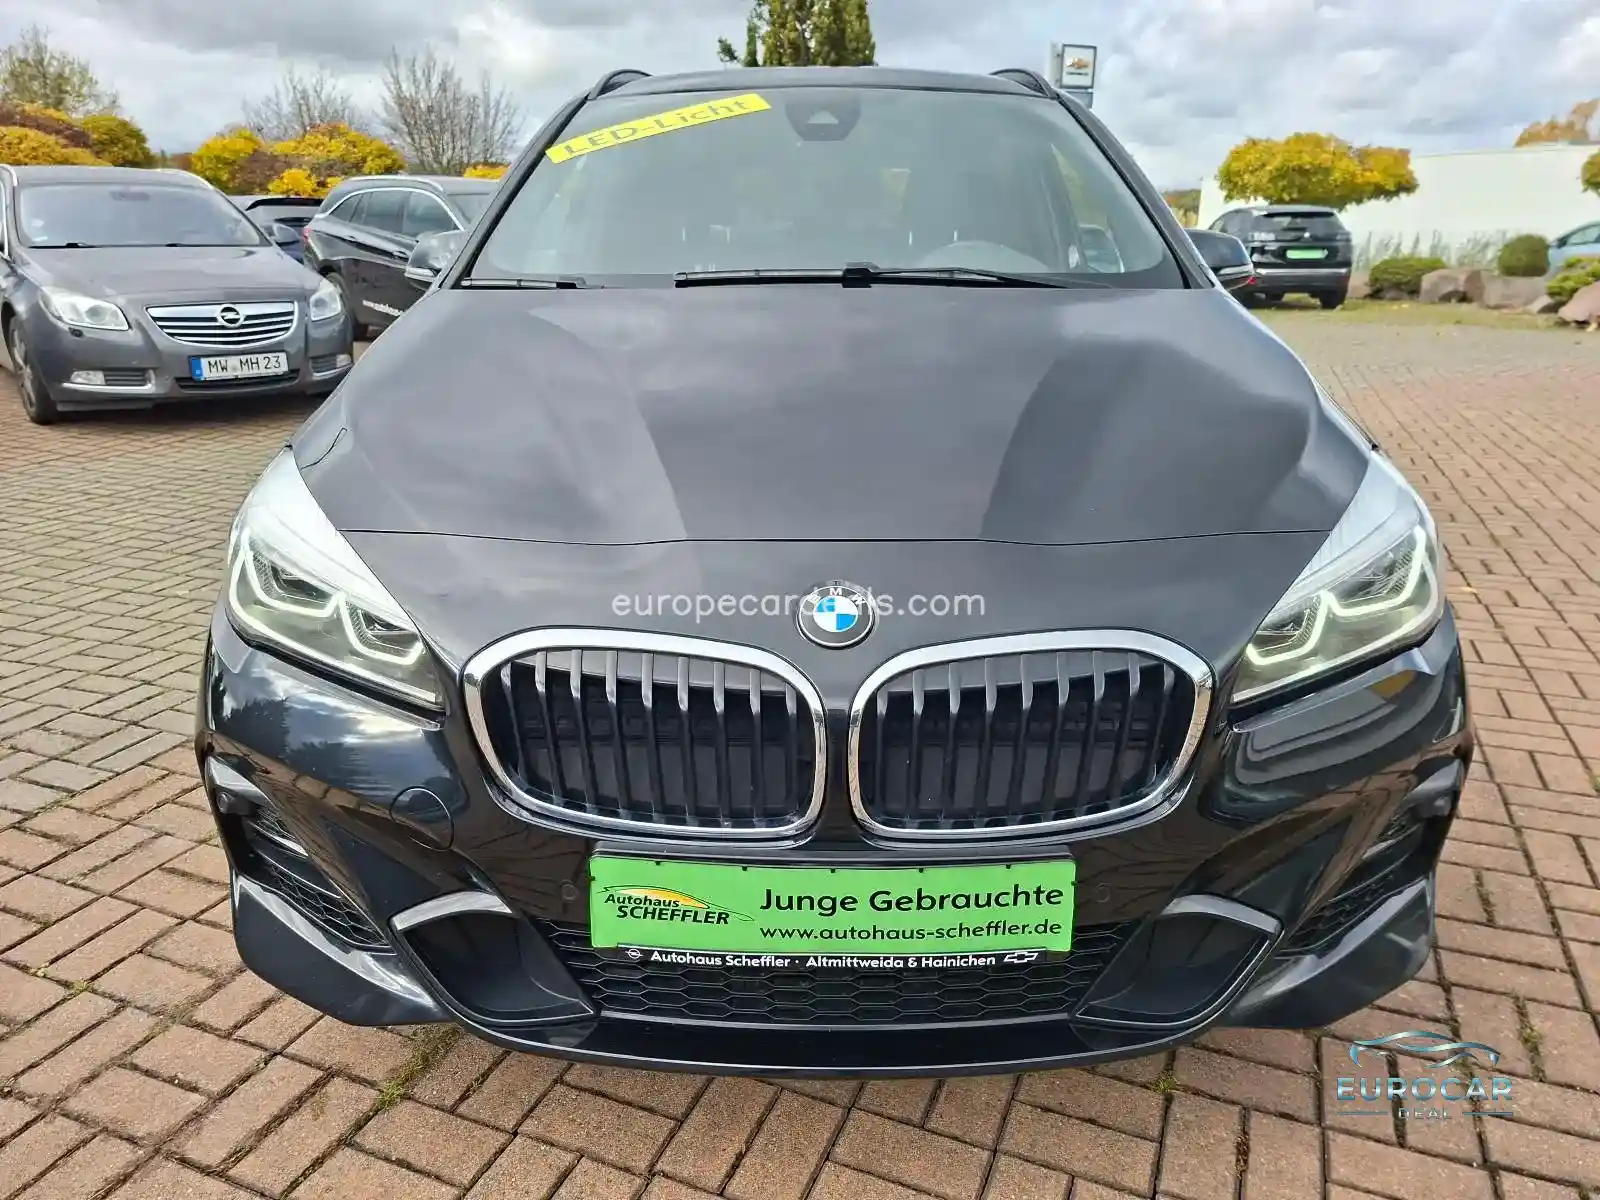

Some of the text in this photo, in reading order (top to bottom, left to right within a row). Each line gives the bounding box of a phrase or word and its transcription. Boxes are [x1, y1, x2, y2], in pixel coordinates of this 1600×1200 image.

[563, 100, 751, 155] LED-Licht
[208, 356, 281, 373] MW MH 23
[604, 893, 680, 908] Autohaus
[760, 883, 1064, 917] Junge Gebrauchte
[616, 905, 730, 925] SCHEFFLER
[760, 919, 1062, 940] www.autohaus-scheffler.de
[650, 950, 996, 968] Autohaus Scheffler Altmittweida & Hainichen
